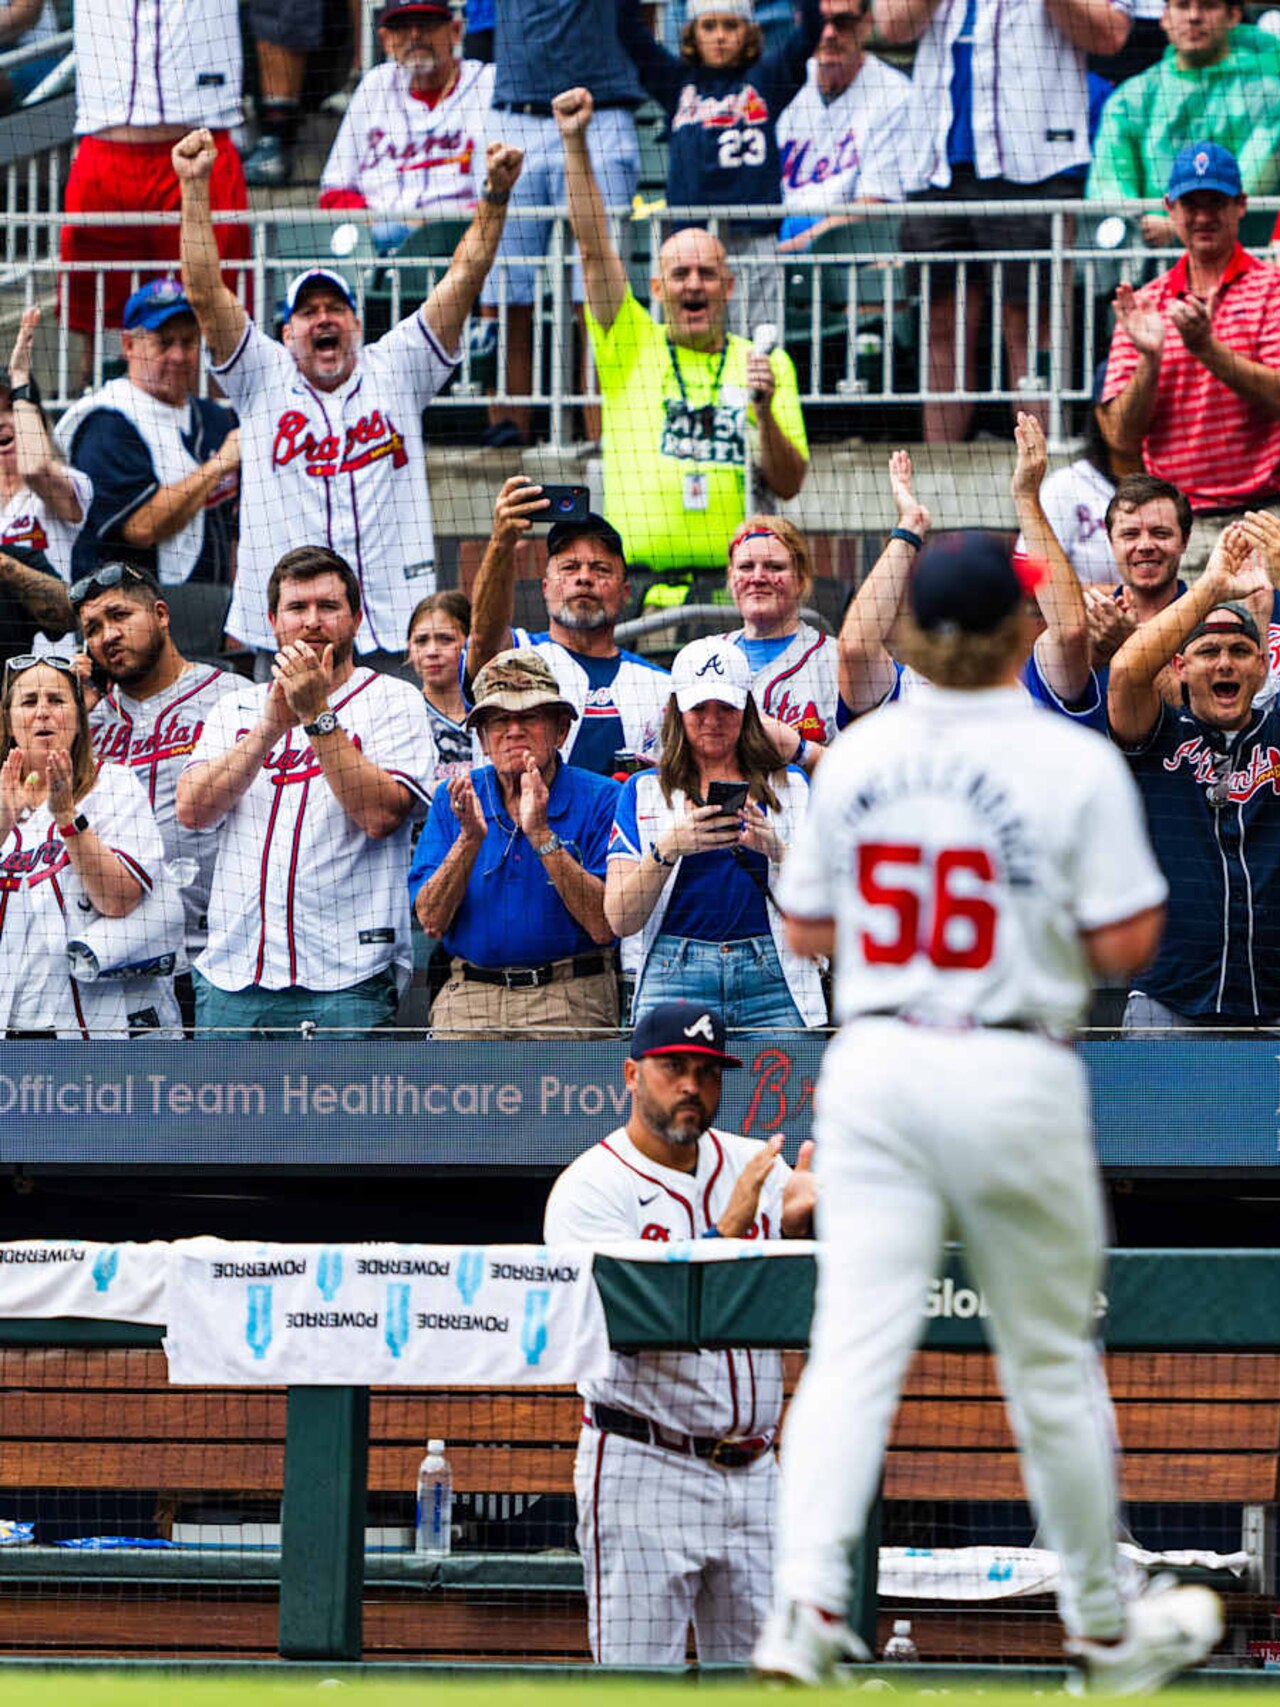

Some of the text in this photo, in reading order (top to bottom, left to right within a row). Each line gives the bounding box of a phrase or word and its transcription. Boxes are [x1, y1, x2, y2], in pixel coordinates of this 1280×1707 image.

[718, 128, 766, 168] 23
[778, 128, 860, 190] Mets
[271, 409, 386, 472] Braves
[695, 653, 725, 676] A
[856, 841, 998, 971] 56
[683, 1013, 715, 1042] A
[147, 1074, 266, 1114] Team
[284, 1075, 524, 1115] Healthcare
[213, 1259, 306, 1279] POWERADE
[357, 1258, 450, 1276] POWERADE
[286, 1312, 378, 1329] POWERADE
[417, 1312, 509, 1333] POWERADE
